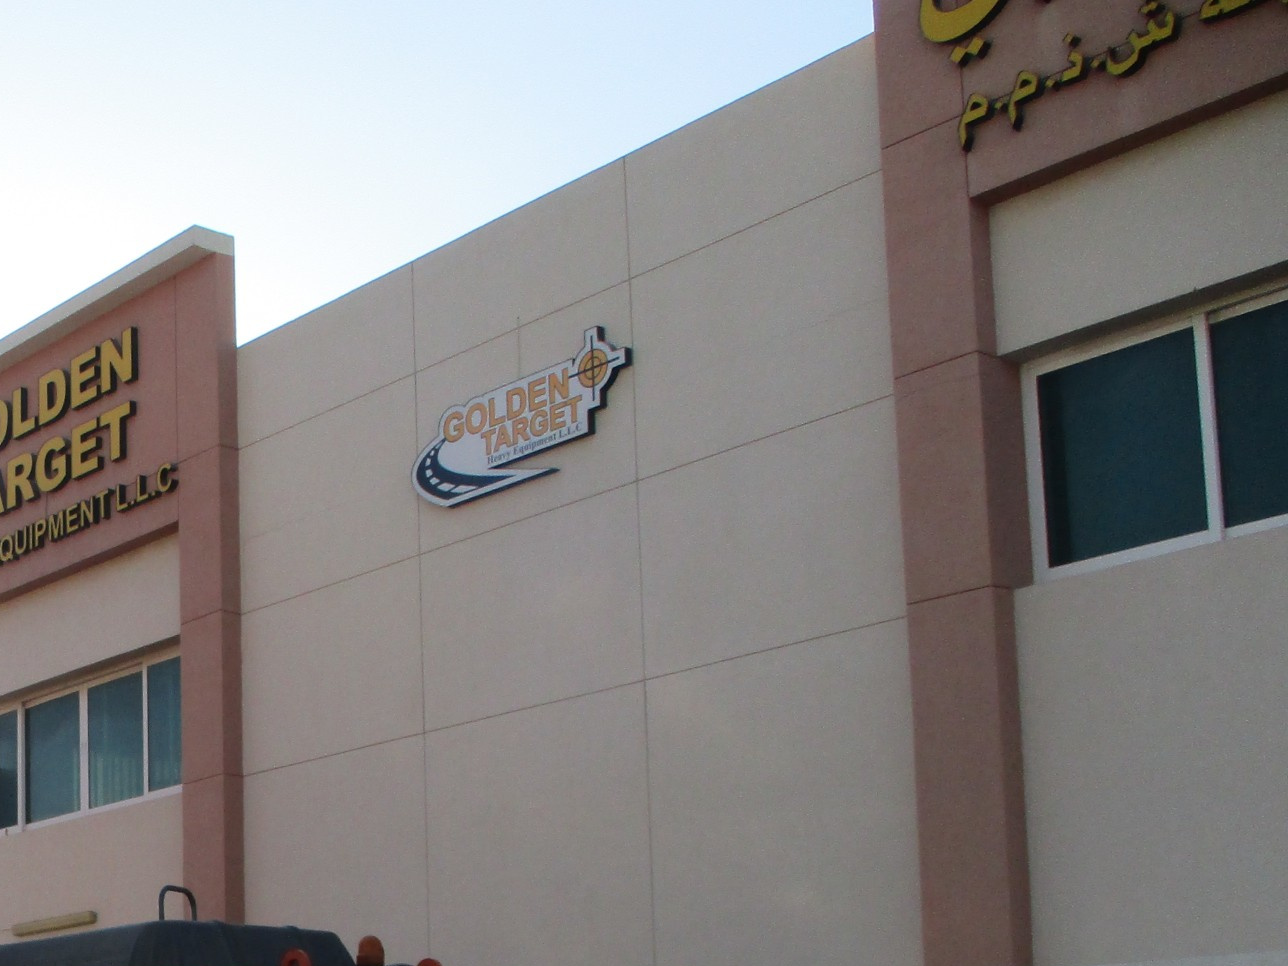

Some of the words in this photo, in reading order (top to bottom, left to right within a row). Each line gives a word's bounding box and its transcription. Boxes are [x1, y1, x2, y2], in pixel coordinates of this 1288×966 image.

[443, 367, 569, 443] GOLDEN
[481, 394, 582, 455] TARGET
[487, 450, 511, 465] Heavy
[513, 433, 557, 456] Equipment
